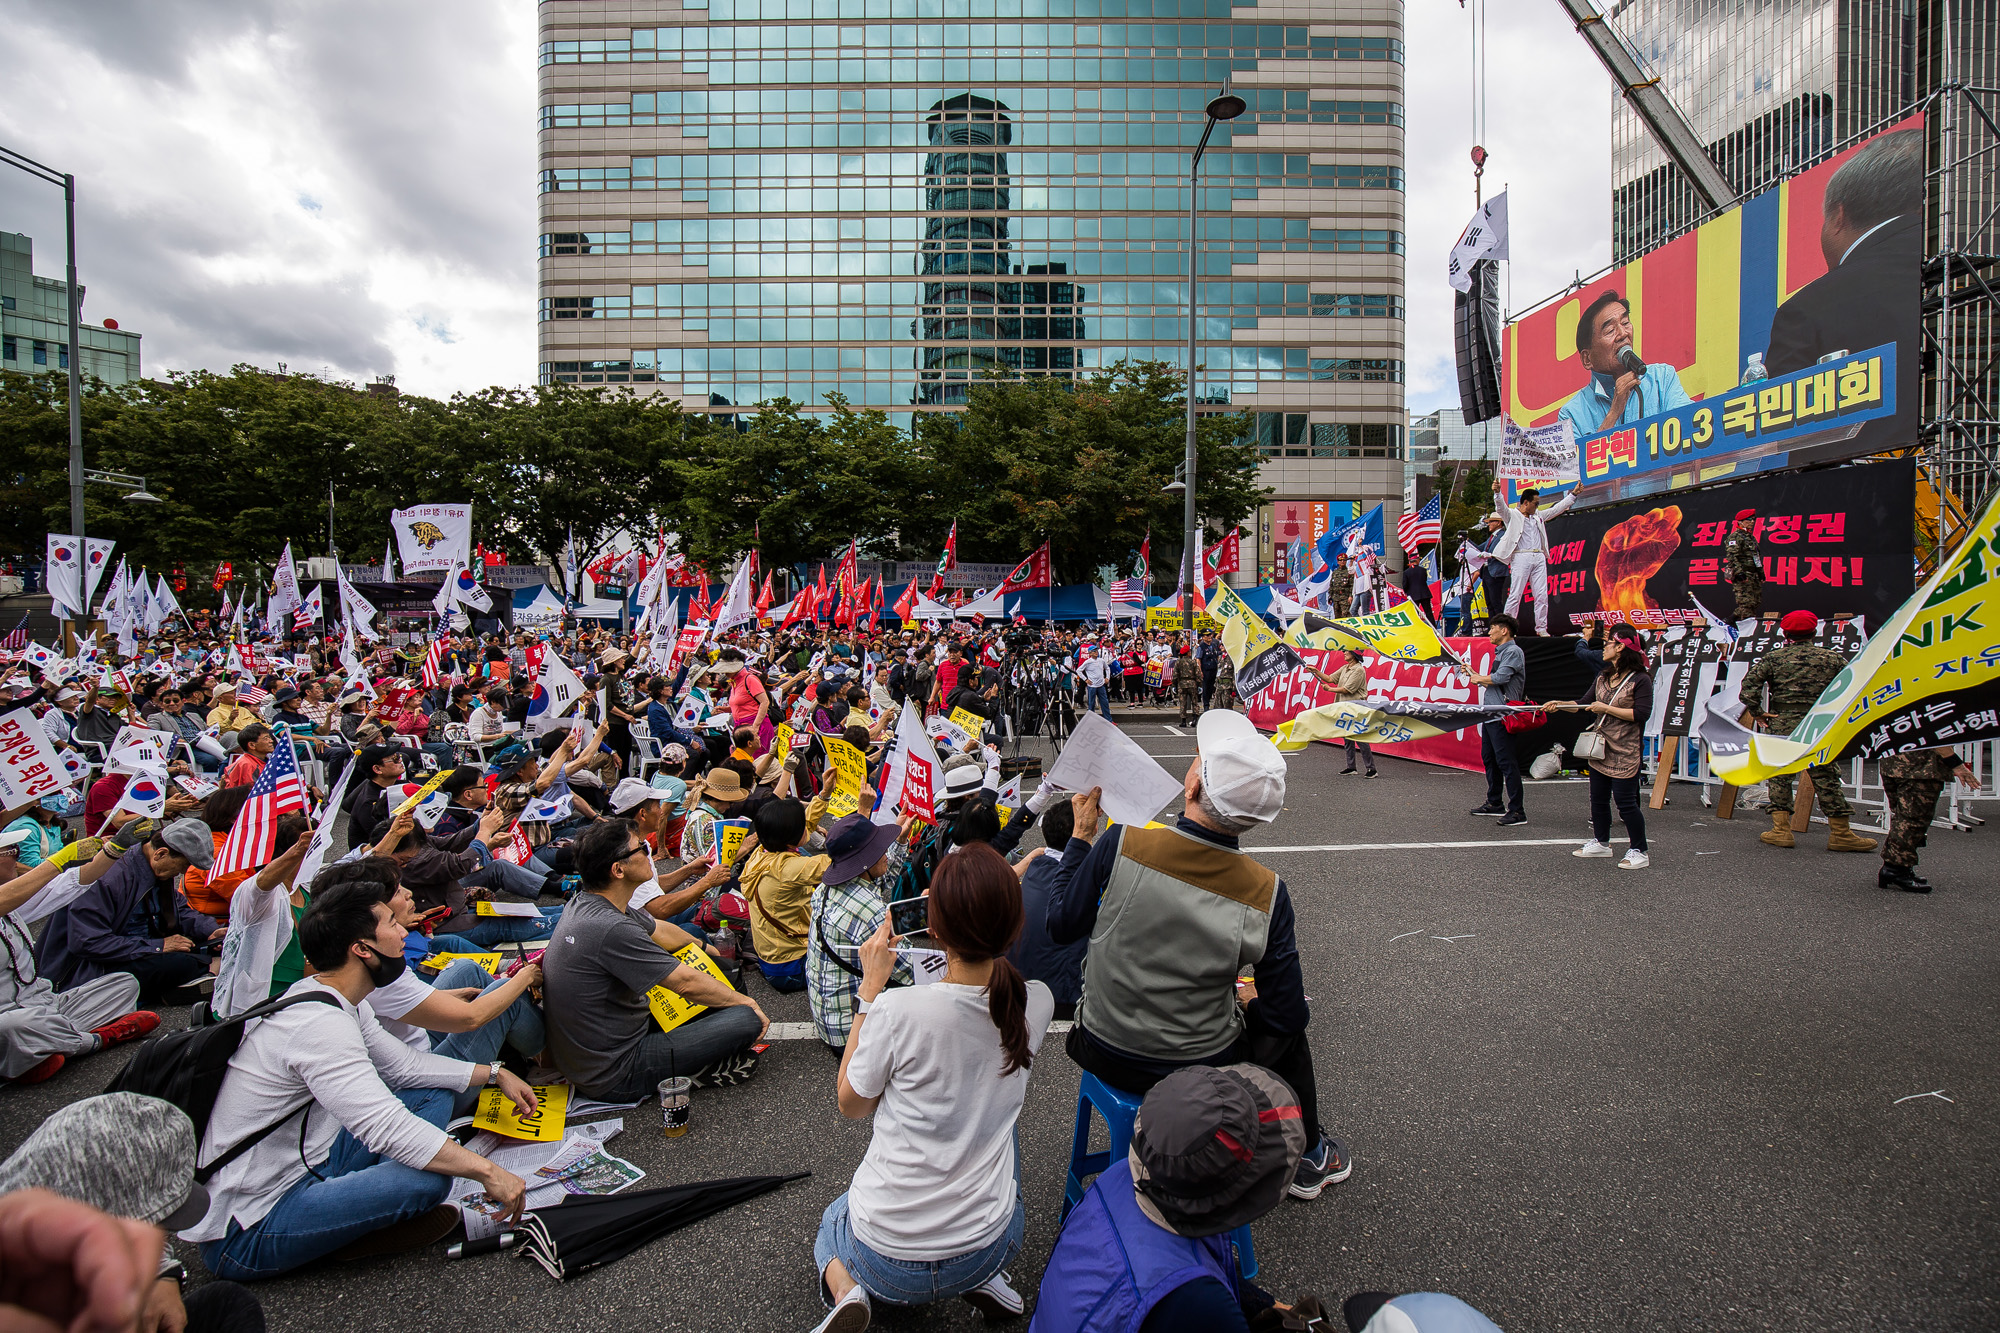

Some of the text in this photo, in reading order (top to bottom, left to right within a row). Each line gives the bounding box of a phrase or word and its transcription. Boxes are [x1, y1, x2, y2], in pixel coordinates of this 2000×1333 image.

[1586, 355, 1881, 474] 탄핵 10.3 국민대회
[1688, 557, 1864, 587] 끝내자!
[1155, 609, 1200, 619] 박근혜대령
[1629, 608, 1701, 625] 운동본부
[1151, 619, 1174, 628] 문재인
[955, 710, 968, 720] 조국
[829, 742, 863, 769] 조국 문재인
[833, 757, 848, 773] 이건
[18, 761, 59, 796] 퇴진
[676, 949, 700, 966] 조국
[660, 999, 680, 1021] 국민행동
